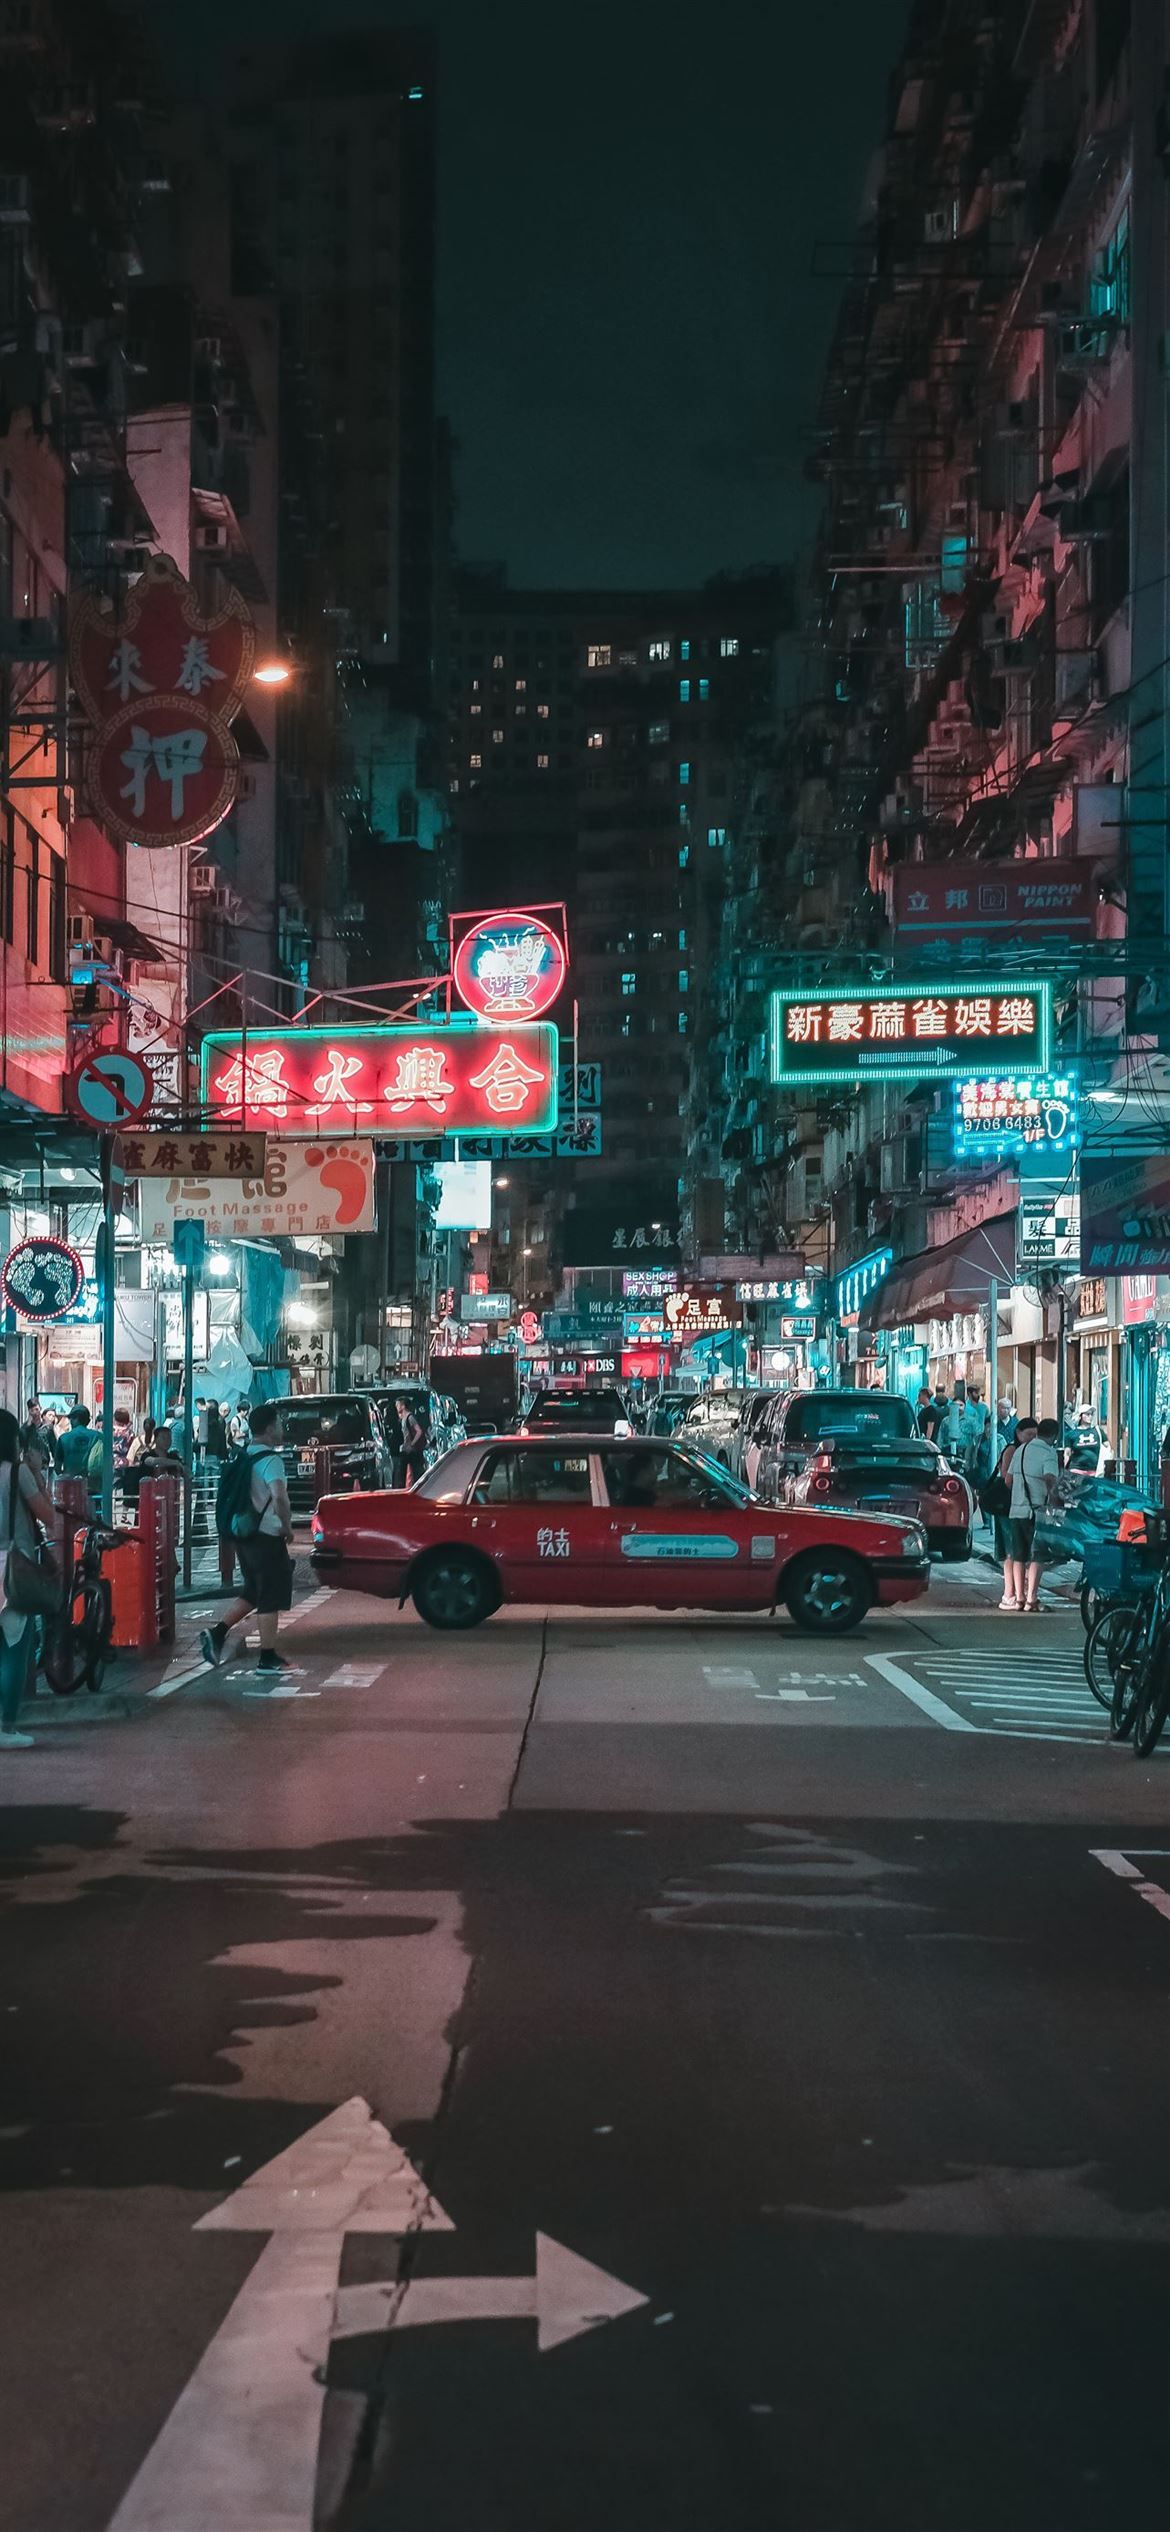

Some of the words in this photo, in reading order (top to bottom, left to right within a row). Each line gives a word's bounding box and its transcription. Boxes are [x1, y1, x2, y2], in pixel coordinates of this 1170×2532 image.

[119, 724, 210, 822] 押
[1017, 883, 1083, 898] NIPPON
[907, 888, 969, 912] 立邦
[1024, 895, 1073, 909] PAINT
[964, 1118, 1001, 1132] 9706
[1005, 1116, 1042, 1131] 6483
[1022, 1129, 1046, 1143] 1/F
[173, 1204, 217, 1218] Foot
[222, 1202, 310, 1217] Massage
[152, 1216, 332, 1237] 足按摩專門店
[626, 1272, 646, 1281] SEX
[646, 1272, 675, 1281] SHOP
[596, 1359, 615, 1372] DBS
[537, 1527, 570, 1541] 的士
[538, 1541, 570, 1557] TAXI
